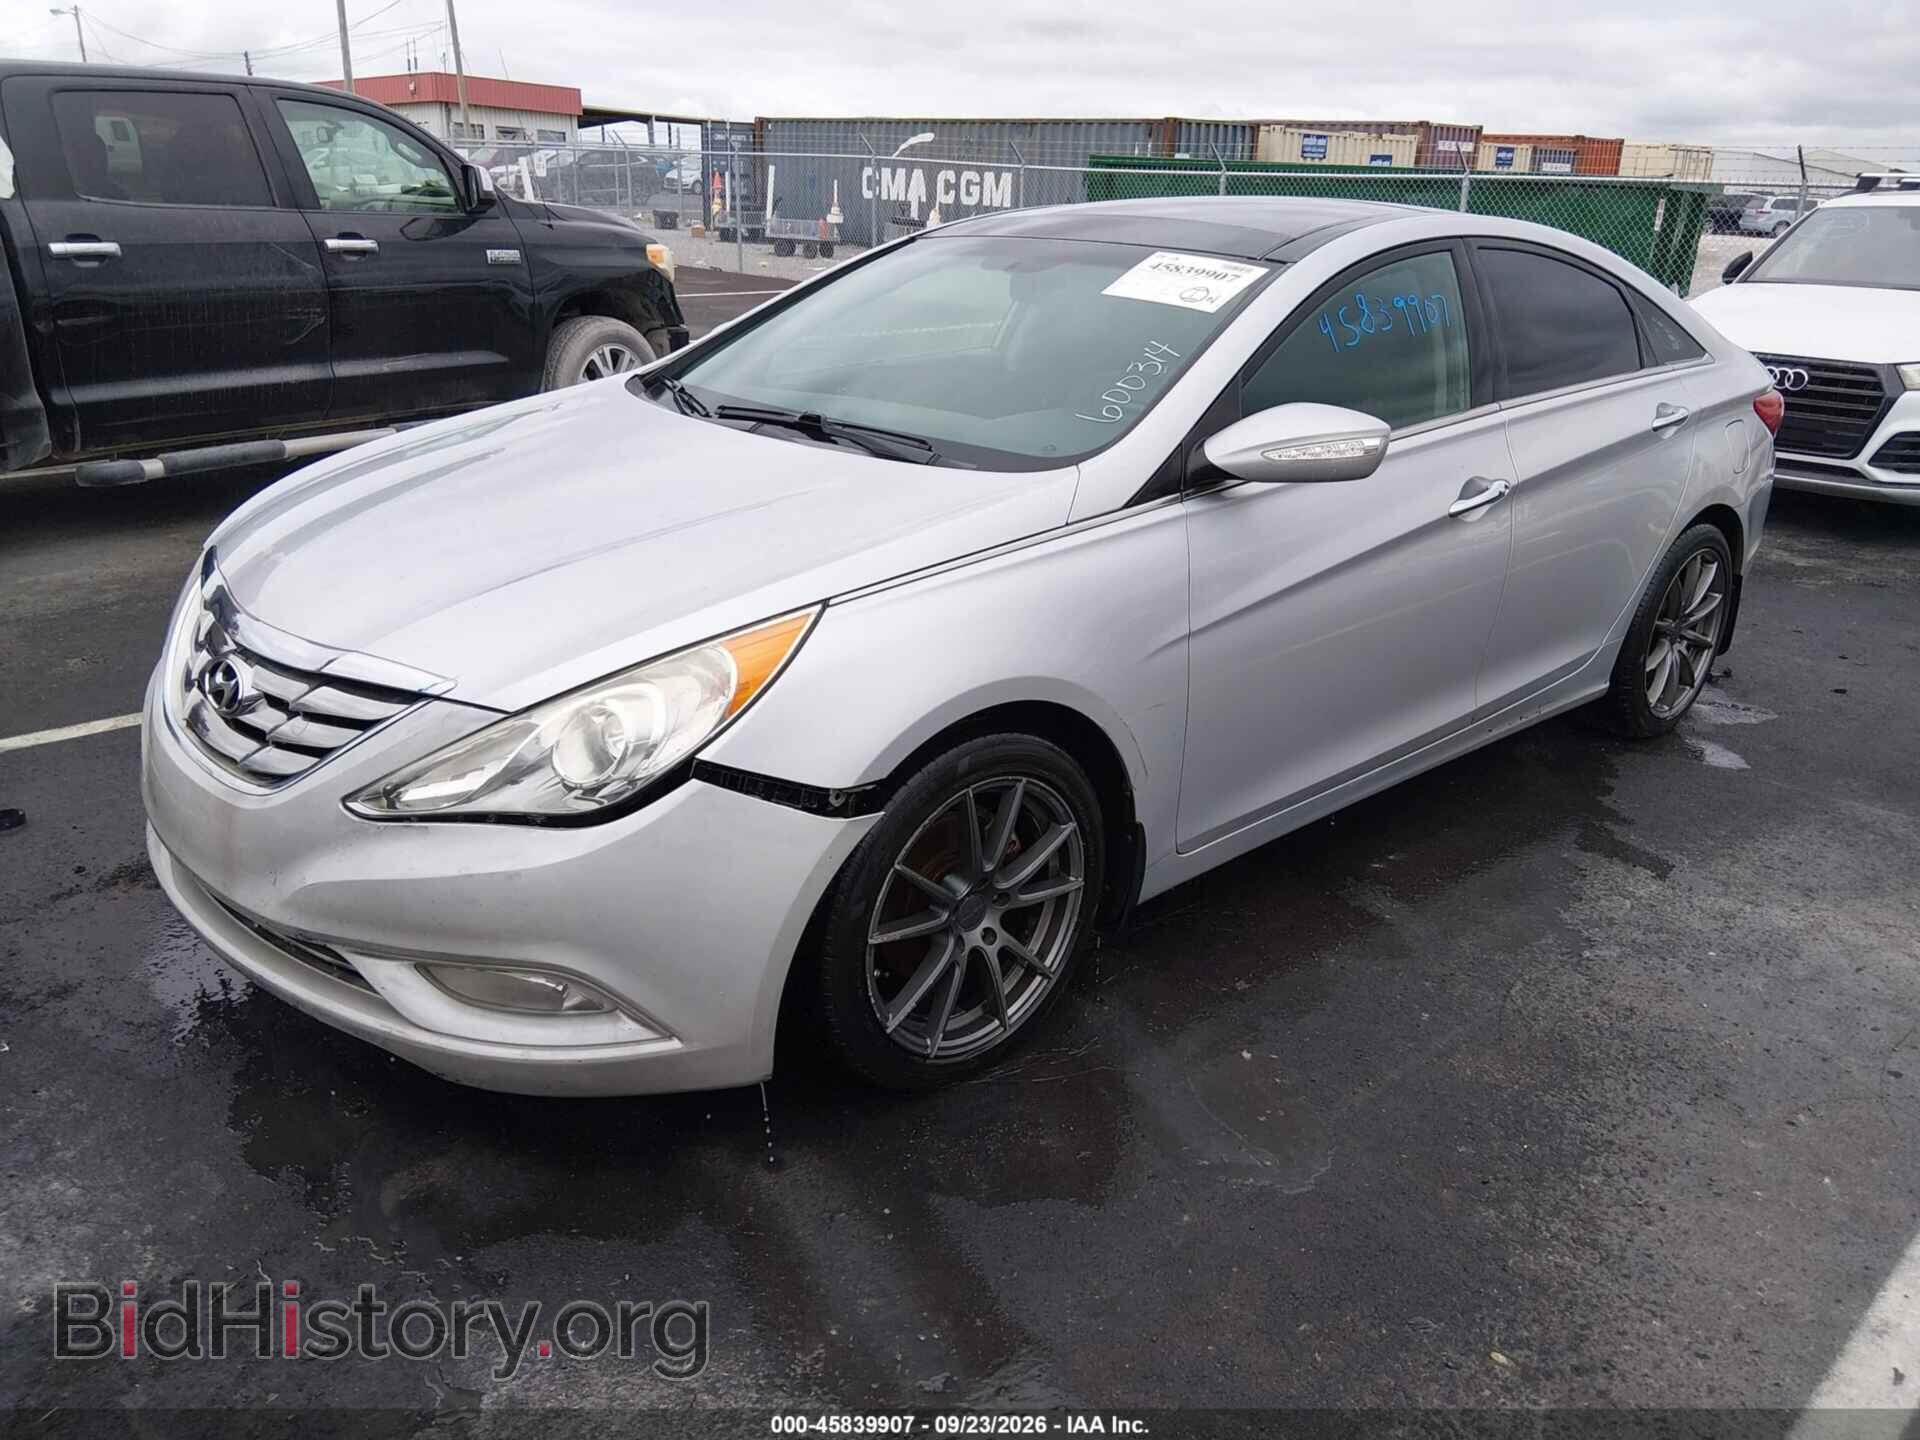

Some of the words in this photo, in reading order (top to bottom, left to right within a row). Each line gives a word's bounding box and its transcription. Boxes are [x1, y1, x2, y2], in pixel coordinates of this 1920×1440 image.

[862, 166, 926, 203] CMA
[936, 170, 1013, 208] CGM
[1151, 262, 1241, 283] 45839907
[1319, 293, 1451, 353] 45839907
